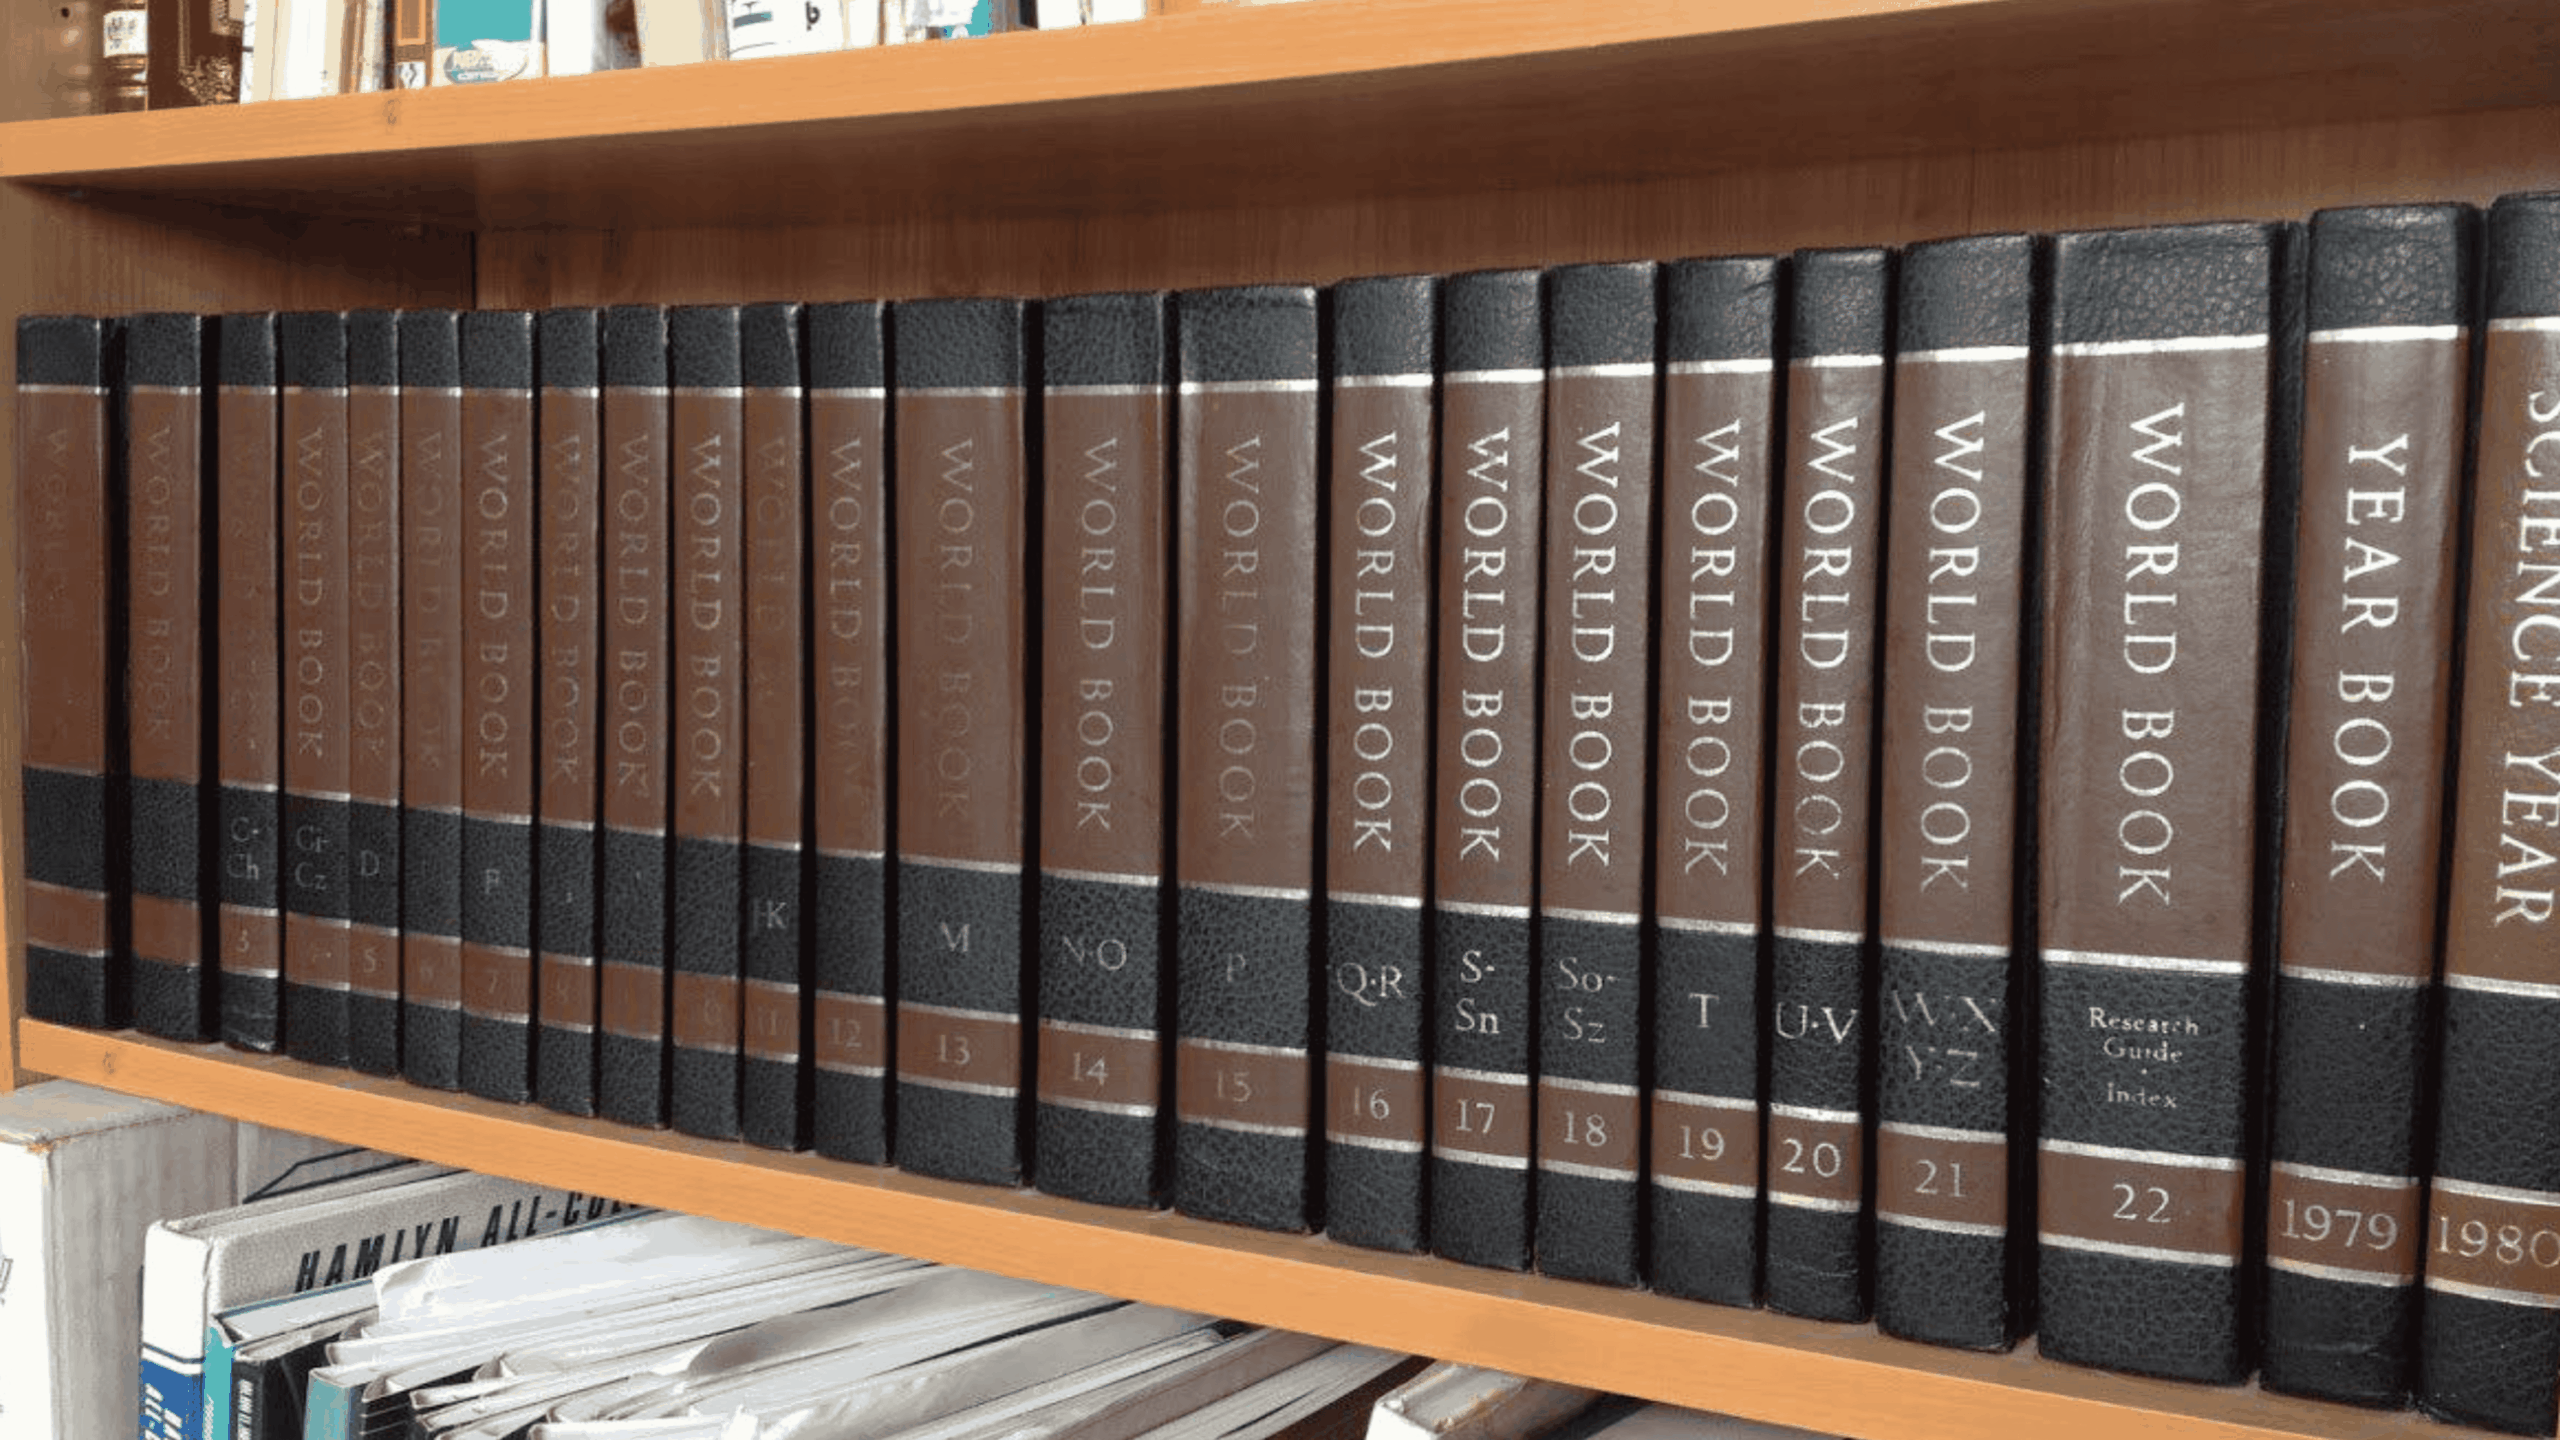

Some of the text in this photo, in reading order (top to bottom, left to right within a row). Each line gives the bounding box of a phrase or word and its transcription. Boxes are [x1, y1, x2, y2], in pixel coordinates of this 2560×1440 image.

[828, 437, 863, 640] WORLD
[939, 439, 973, 645] WORLD
[298, 427, 325, 758] WORLD BOOK
[480, 434, 508, 779] WORLD BOOK
[551, 435, 580, 785] WORLD BOOK
[618, 434, 650, 799] WORLD BOOK
[690, 434, 722, 798] WORLD BOOK
[1077, 438, 1117, 831] WORLD BOOK
[1219, 436, 1261, 838] WORLD BOOK
[1352, 431, 1397, 852] WORLD BOOK
[1459, 427, 1509, 863] WORLD BOOK
[1568, 421, 1620, 866] WORLD BOOK
[1684, 419, 1741, 876] WORLD BOOK
[1795, 417, 1858, 880] WORLD BOOK
[1920, 410, 1986, 892] WORLD BOOK
[2118, 402, 2184, 905] WORLD BOOK
[2330, 434, 2409, 883] YEAR BOOK
[2496, 390, 2560, 927] SCIENCE YEAR
[361, 850, 380, 877] D
[940, 922, 971, 952] M
[362, 948, 378, 974] 5
[1225, 953, 1247, 983] P
[1455, 998, 1500, 1034] Sn
[1563, 1007, 1607, 1043] Sz
[1689, 993, 1720, 1029] T
[2088, 1006, 2199, 1036] Research
[829, 1018, 864, 1052] 12
[937, 1034, 972, 1066] 13
[2102, 1036, 2183, 1063] Guide
[1072, 1052, 1110, 1087] 14
[1216, 1071, 1253, 1103] 15
[1353, 1086, 1391, 1121] 16
[2107, 1081, 2178, 1109] Index
[1456, 1100, 1496, 1135] 17
[1564, 1111, 1608, 1147] 18
[1679, 1127, 1726, 1161] 19
[1783, 1138, 1842, 1178] 20
[1915, 1159, 1967, 1199] 21
[2111, 1184, 2172, 1225] 22
[2281, 1198, 2399, 1251] 1979
[2432, 1215, 2560, 1269] 1980
